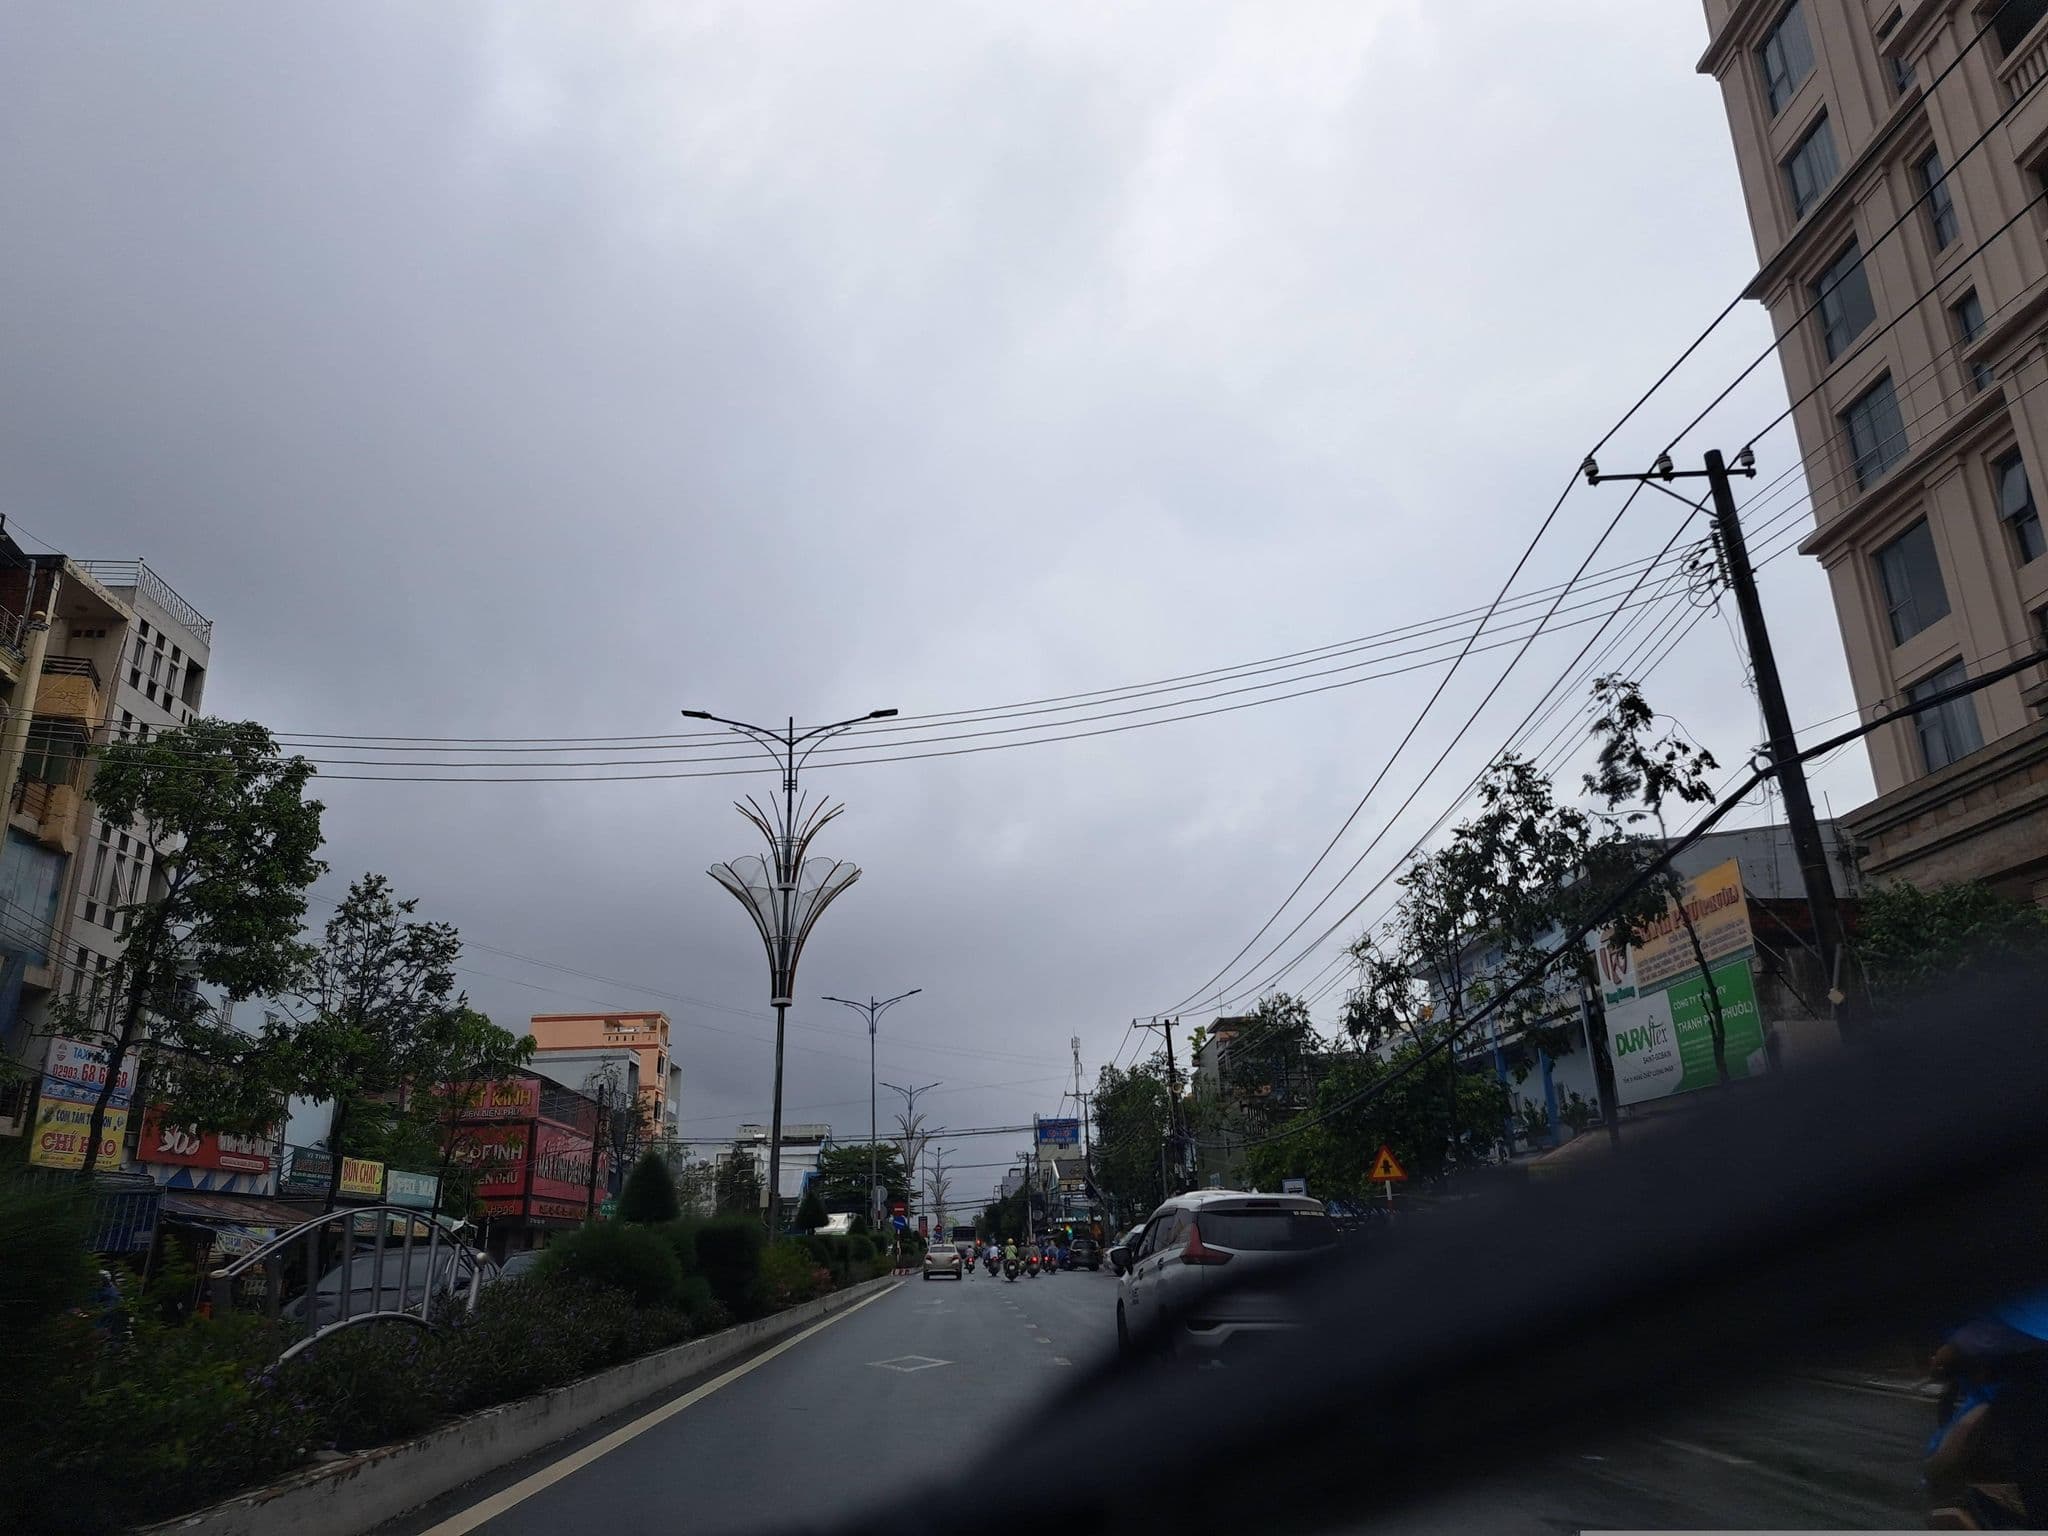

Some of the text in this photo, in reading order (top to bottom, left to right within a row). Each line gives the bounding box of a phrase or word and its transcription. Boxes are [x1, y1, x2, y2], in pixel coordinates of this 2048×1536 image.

[1677, 1017, 1703, 1034] THANH
[81, 1063, 97, 1082] 68
[40, 1129, 77, 1153] CHÍ
